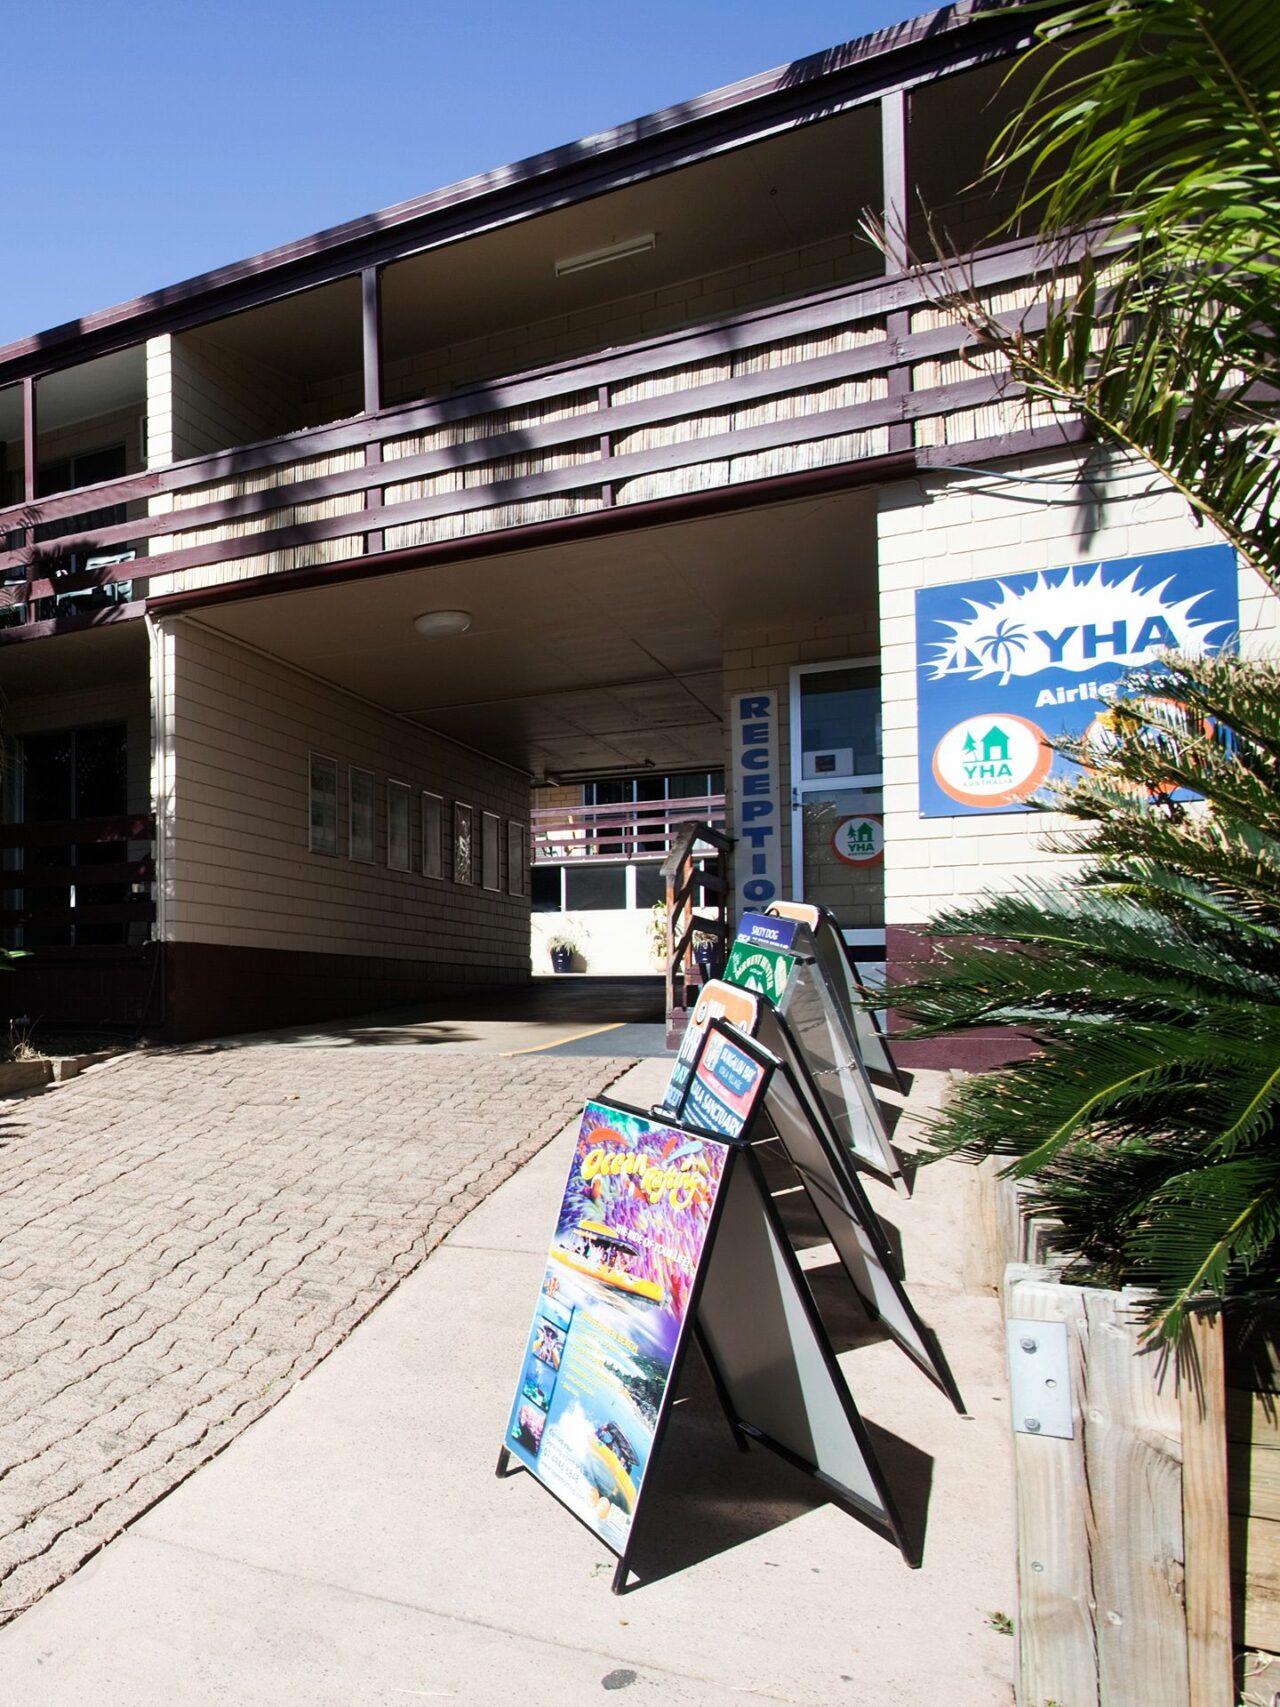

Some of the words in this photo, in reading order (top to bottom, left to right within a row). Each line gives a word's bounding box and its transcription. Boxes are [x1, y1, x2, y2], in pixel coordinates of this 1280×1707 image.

[1032, 615, 1181, 663] YHA
[1035, 681, 1117, 708] Airlie
[962, 763, 1013, 779] YHA
[963, 778, 1014, 787] AUSTRALIA
[740, 696, 776, 913] RECEPTIO
[848, 844, 875, 852] YHA
[765, 927, 780, 940] DOG
[701, 1094, 745, 1138] SANCTUARY
[581, 1149, 648, 1180] Ocean
